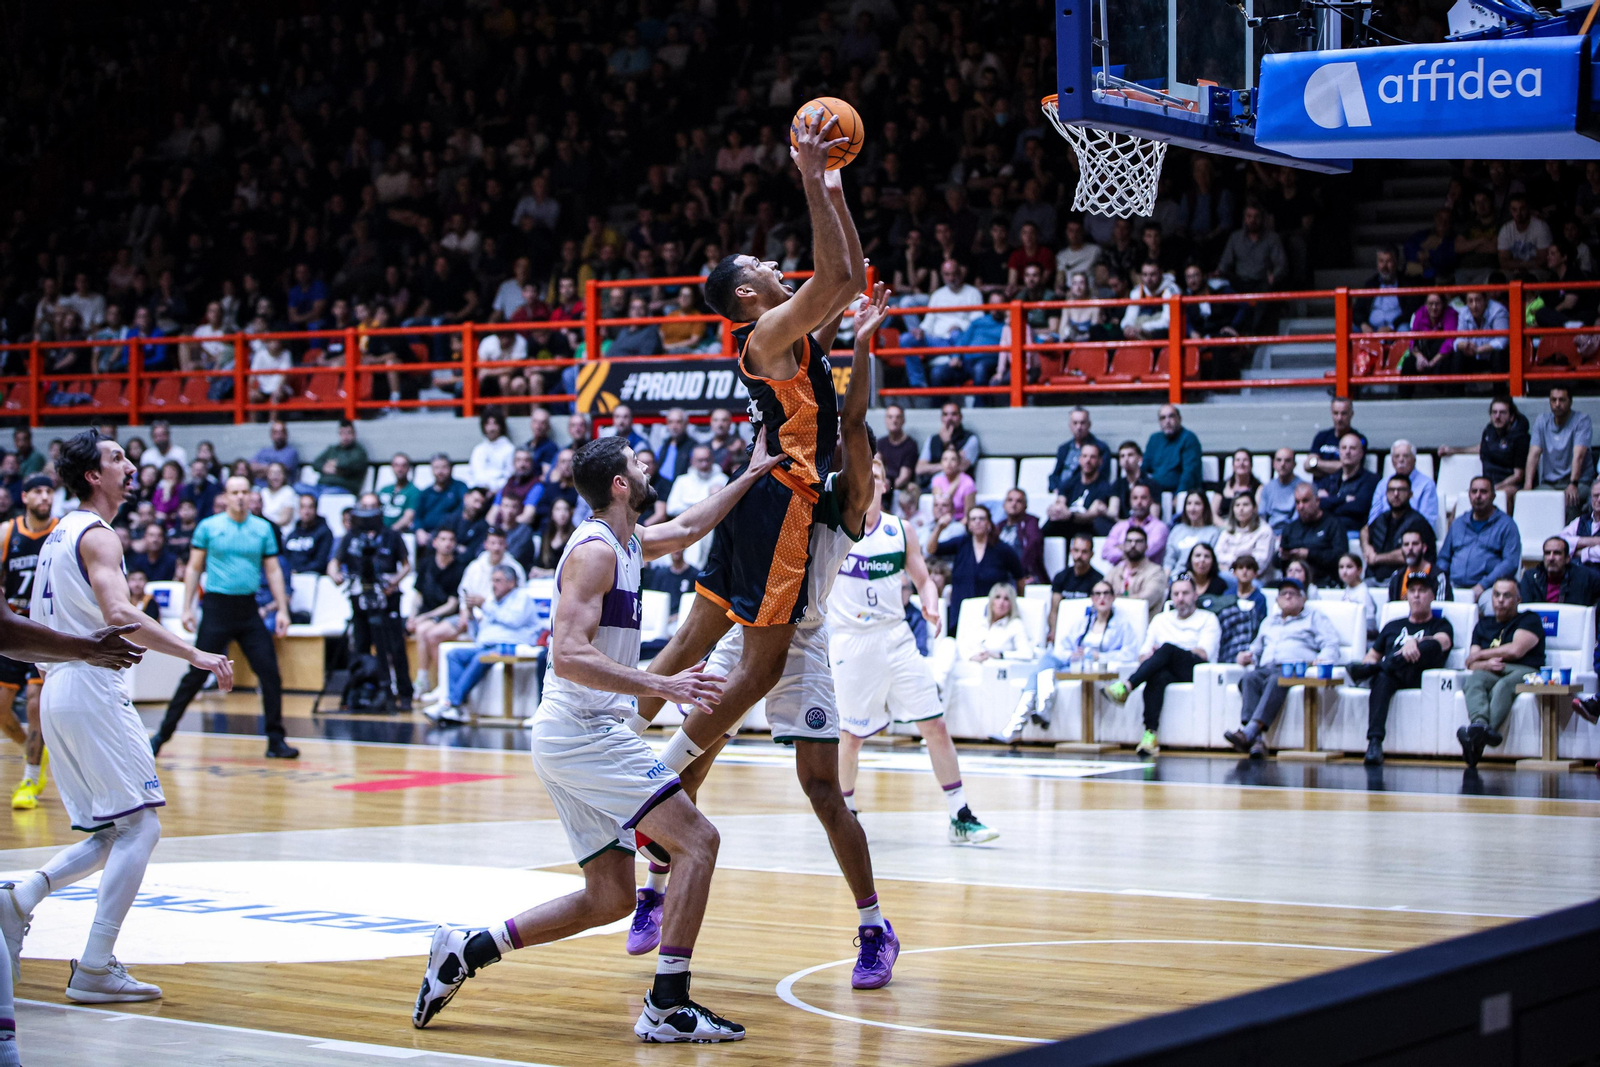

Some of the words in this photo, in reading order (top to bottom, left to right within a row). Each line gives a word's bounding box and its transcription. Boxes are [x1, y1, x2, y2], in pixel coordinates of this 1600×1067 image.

[1378, 57, 1542, 104] affidea
[620, 371, 697, 401] #PROUD
[700, 370, 734, 400] TO
[858, 560, 895, 575] Unicaja
[866, 586, 878, 607] 9
[1440, 678, 1453, 691] 24
